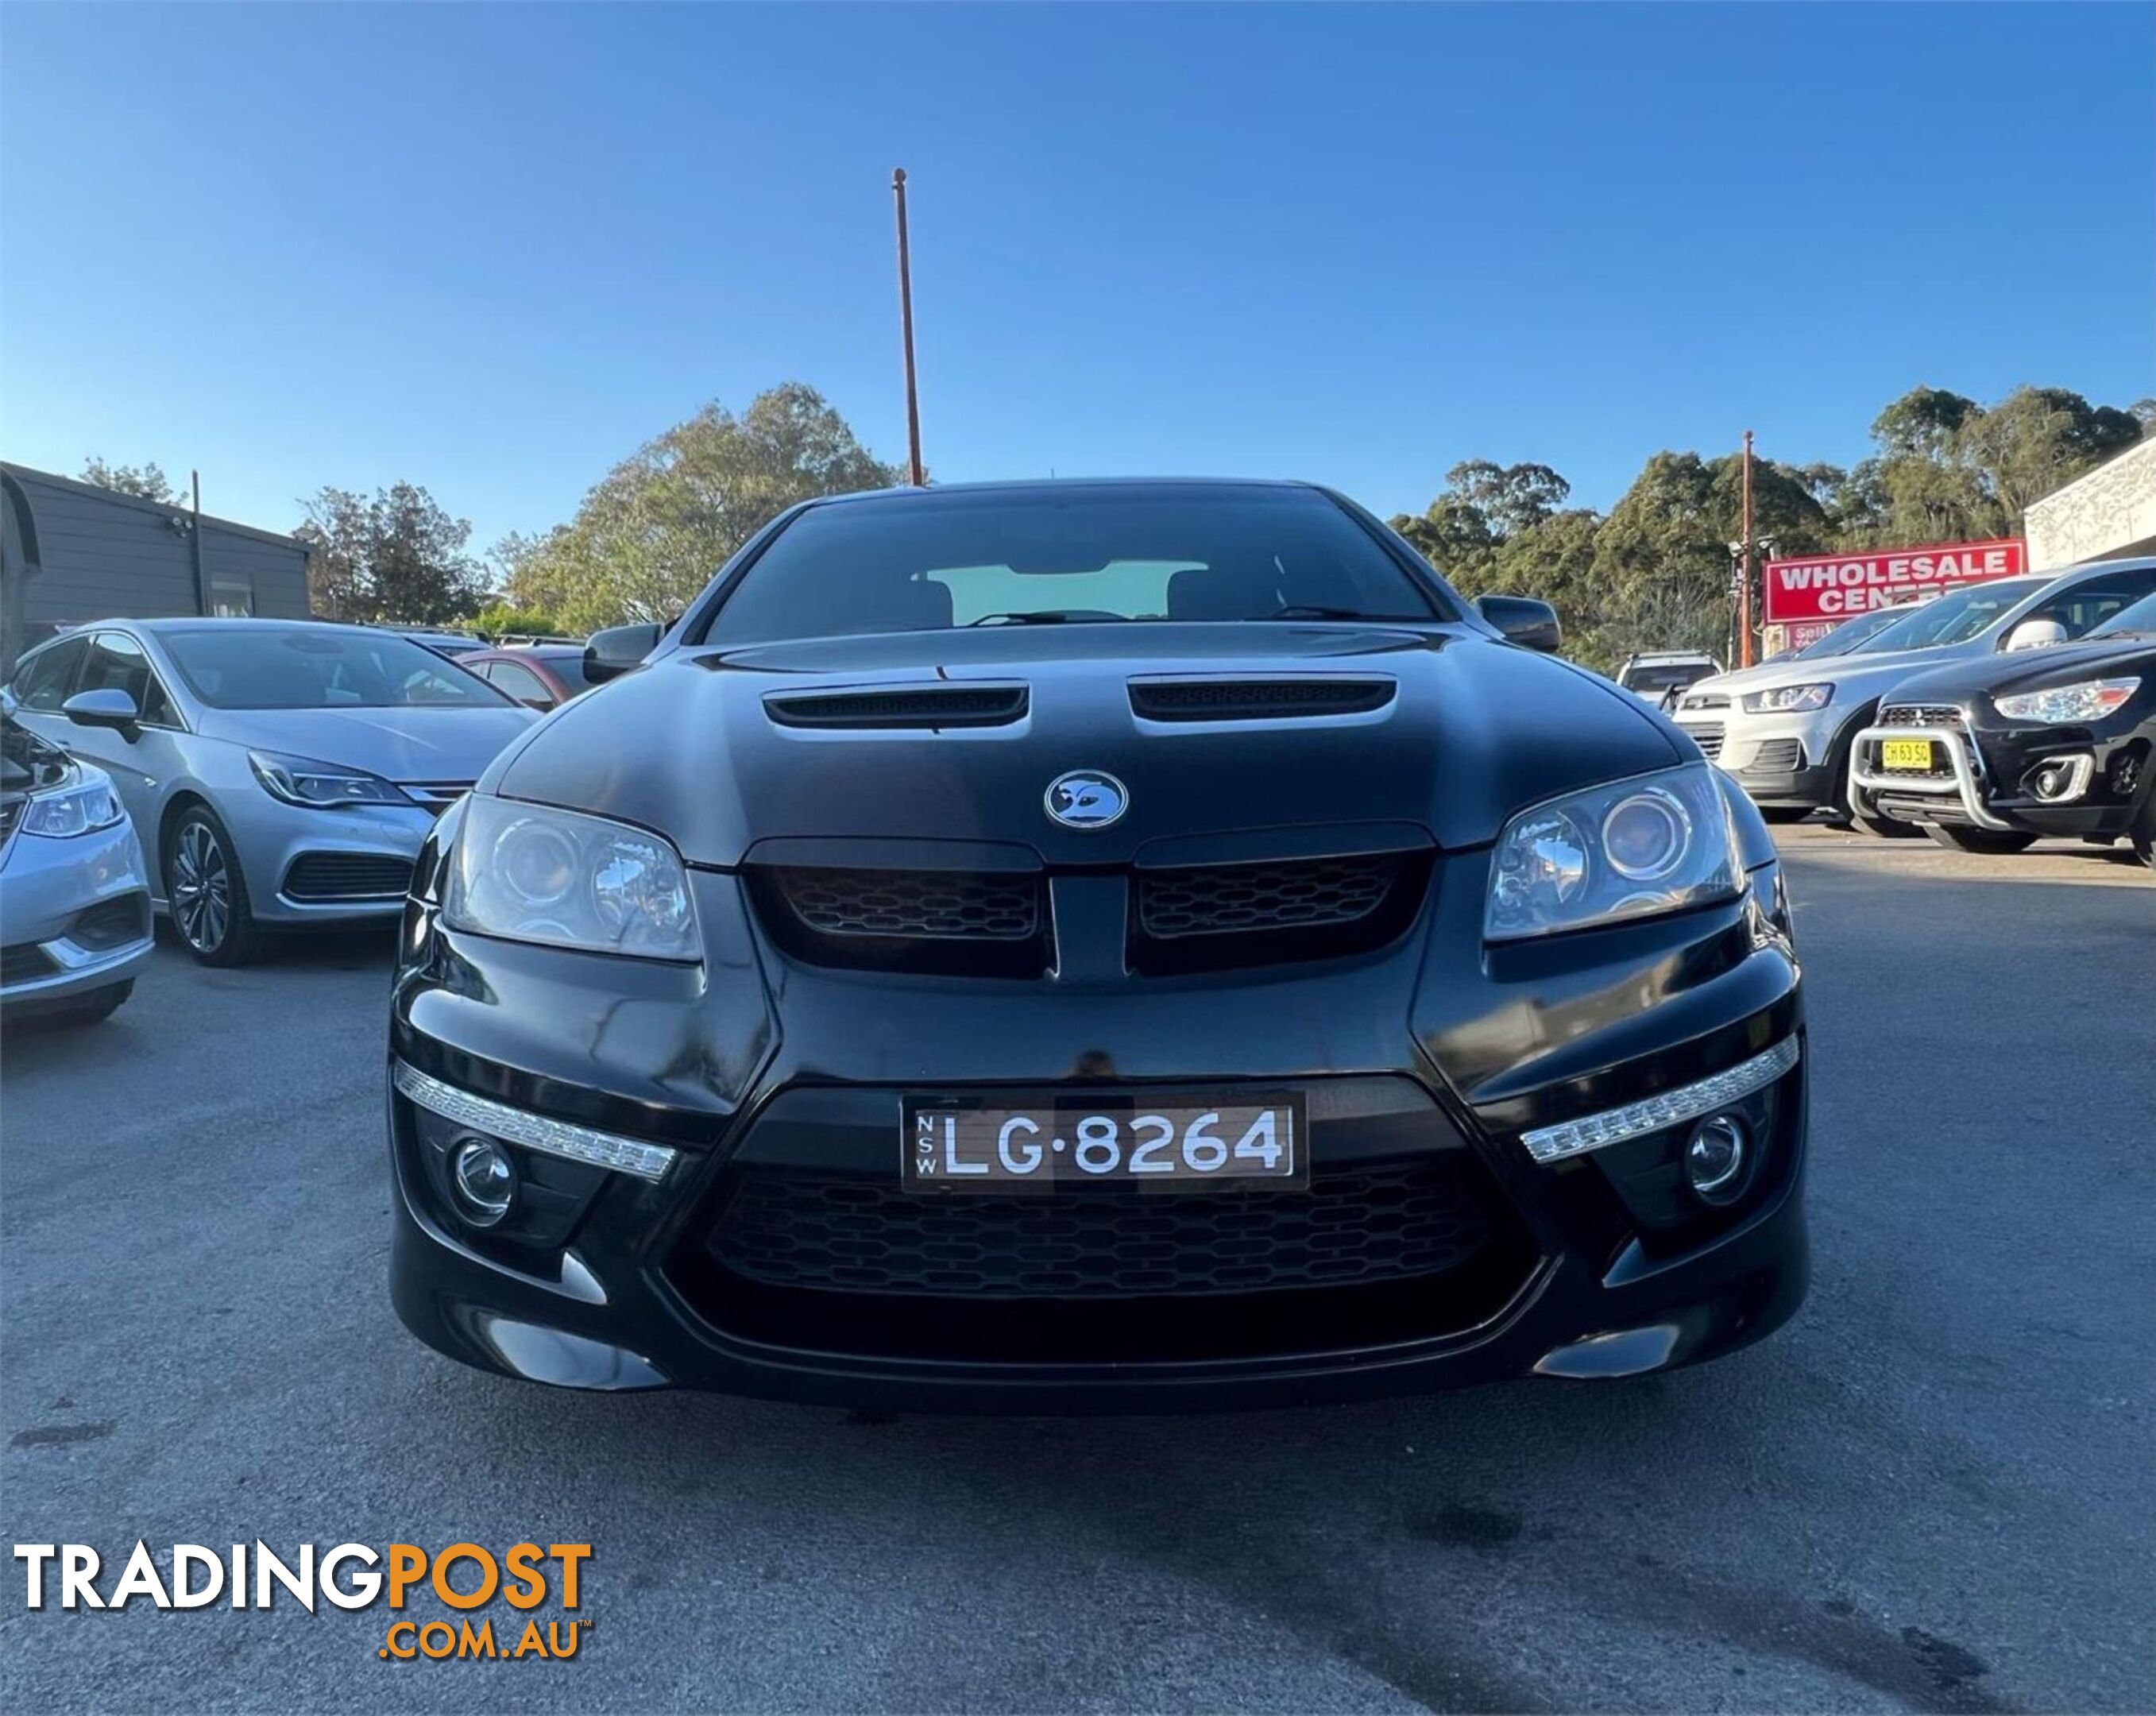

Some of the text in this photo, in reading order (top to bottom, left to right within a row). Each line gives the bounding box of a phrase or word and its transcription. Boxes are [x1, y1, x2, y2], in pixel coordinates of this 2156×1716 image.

[1779, 551, 2007, 590] WHOLESALE
[1818, 581, 1967, 613] CEN
[1899, 744, 1912, 760] 63
[916, 1115, 937, 1174] NSW
